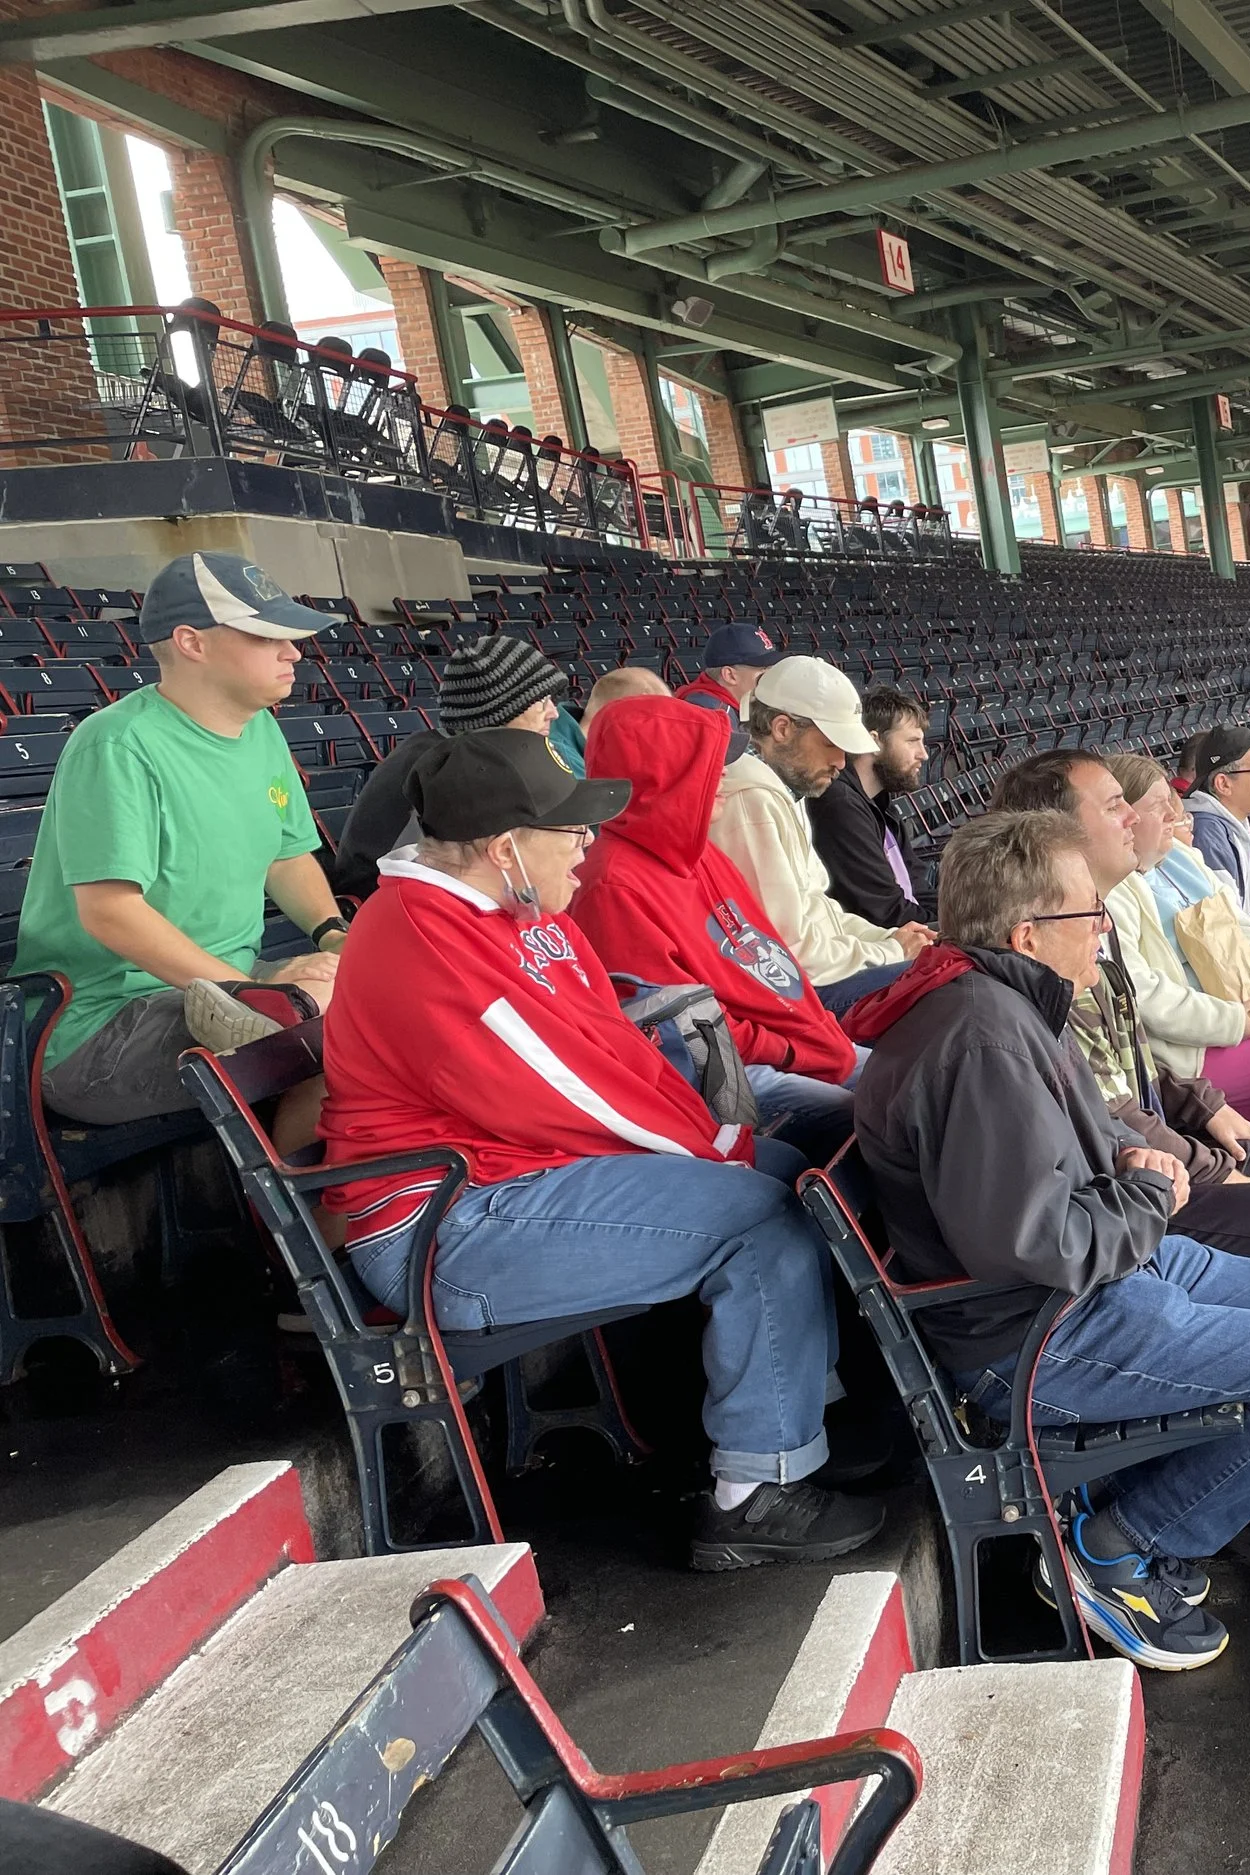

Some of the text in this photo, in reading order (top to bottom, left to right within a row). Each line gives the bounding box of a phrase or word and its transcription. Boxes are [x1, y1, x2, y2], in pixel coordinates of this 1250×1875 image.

[888, 242, 907, 281] 14
[41, 672, 52, 685] 8
[133, 671, 143, 684] 9
[313, 721, 324, 735] 8
[388, 716, 398, 729] 9
[15, 742, 30, 760] 5
[373, 1362, 395, 1384] 5
[964, 1464, 987, 1484] 4
[297, 1801, 357, 1875] 18
